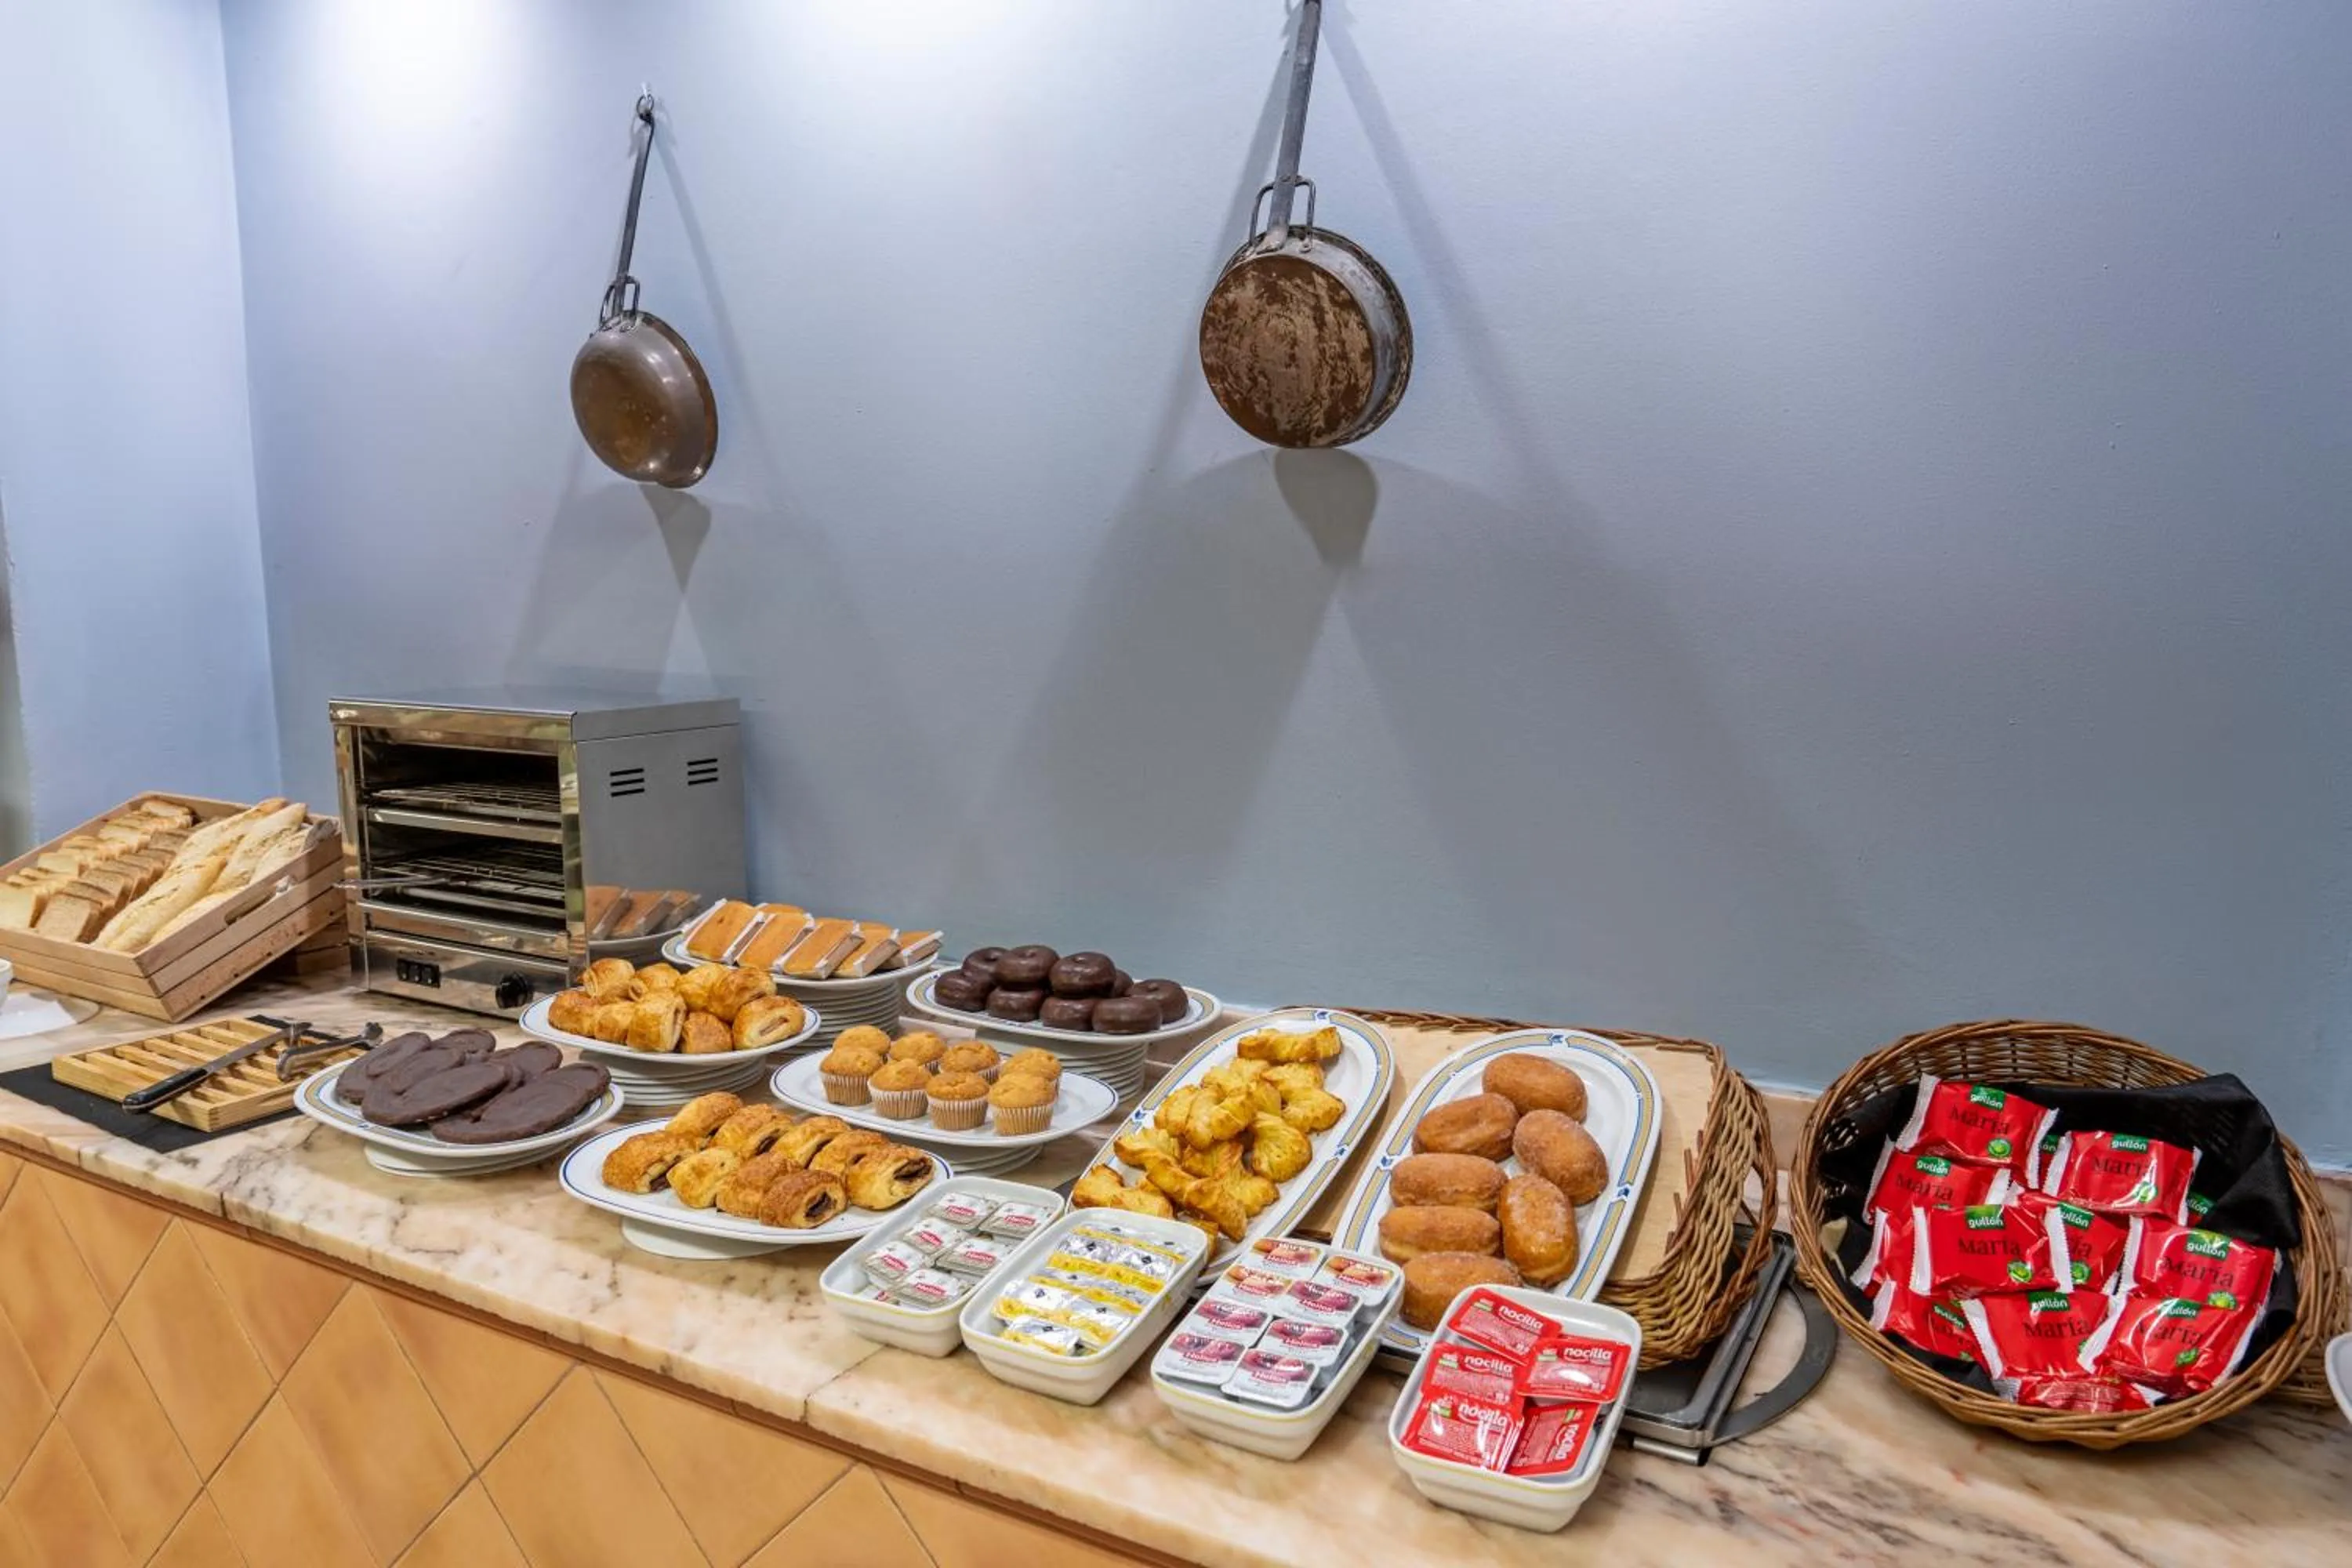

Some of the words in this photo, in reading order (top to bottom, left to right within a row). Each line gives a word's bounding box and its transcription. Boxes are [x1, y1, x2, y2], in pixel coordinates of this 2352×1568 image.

[2111, 1139, 2147, 1152] gullón
[1968, 1216, 2005, 1229] gullón
[2061, 1211, 2090, 1229] ullón
[1499, 1305, 1544, 1330] nocilla
[1563, 1347, 1613, 1361] nocilla
[1464, 1355, 1514, 1374] nocilla
[1458, 1401, 1508, 1425] nocilla
